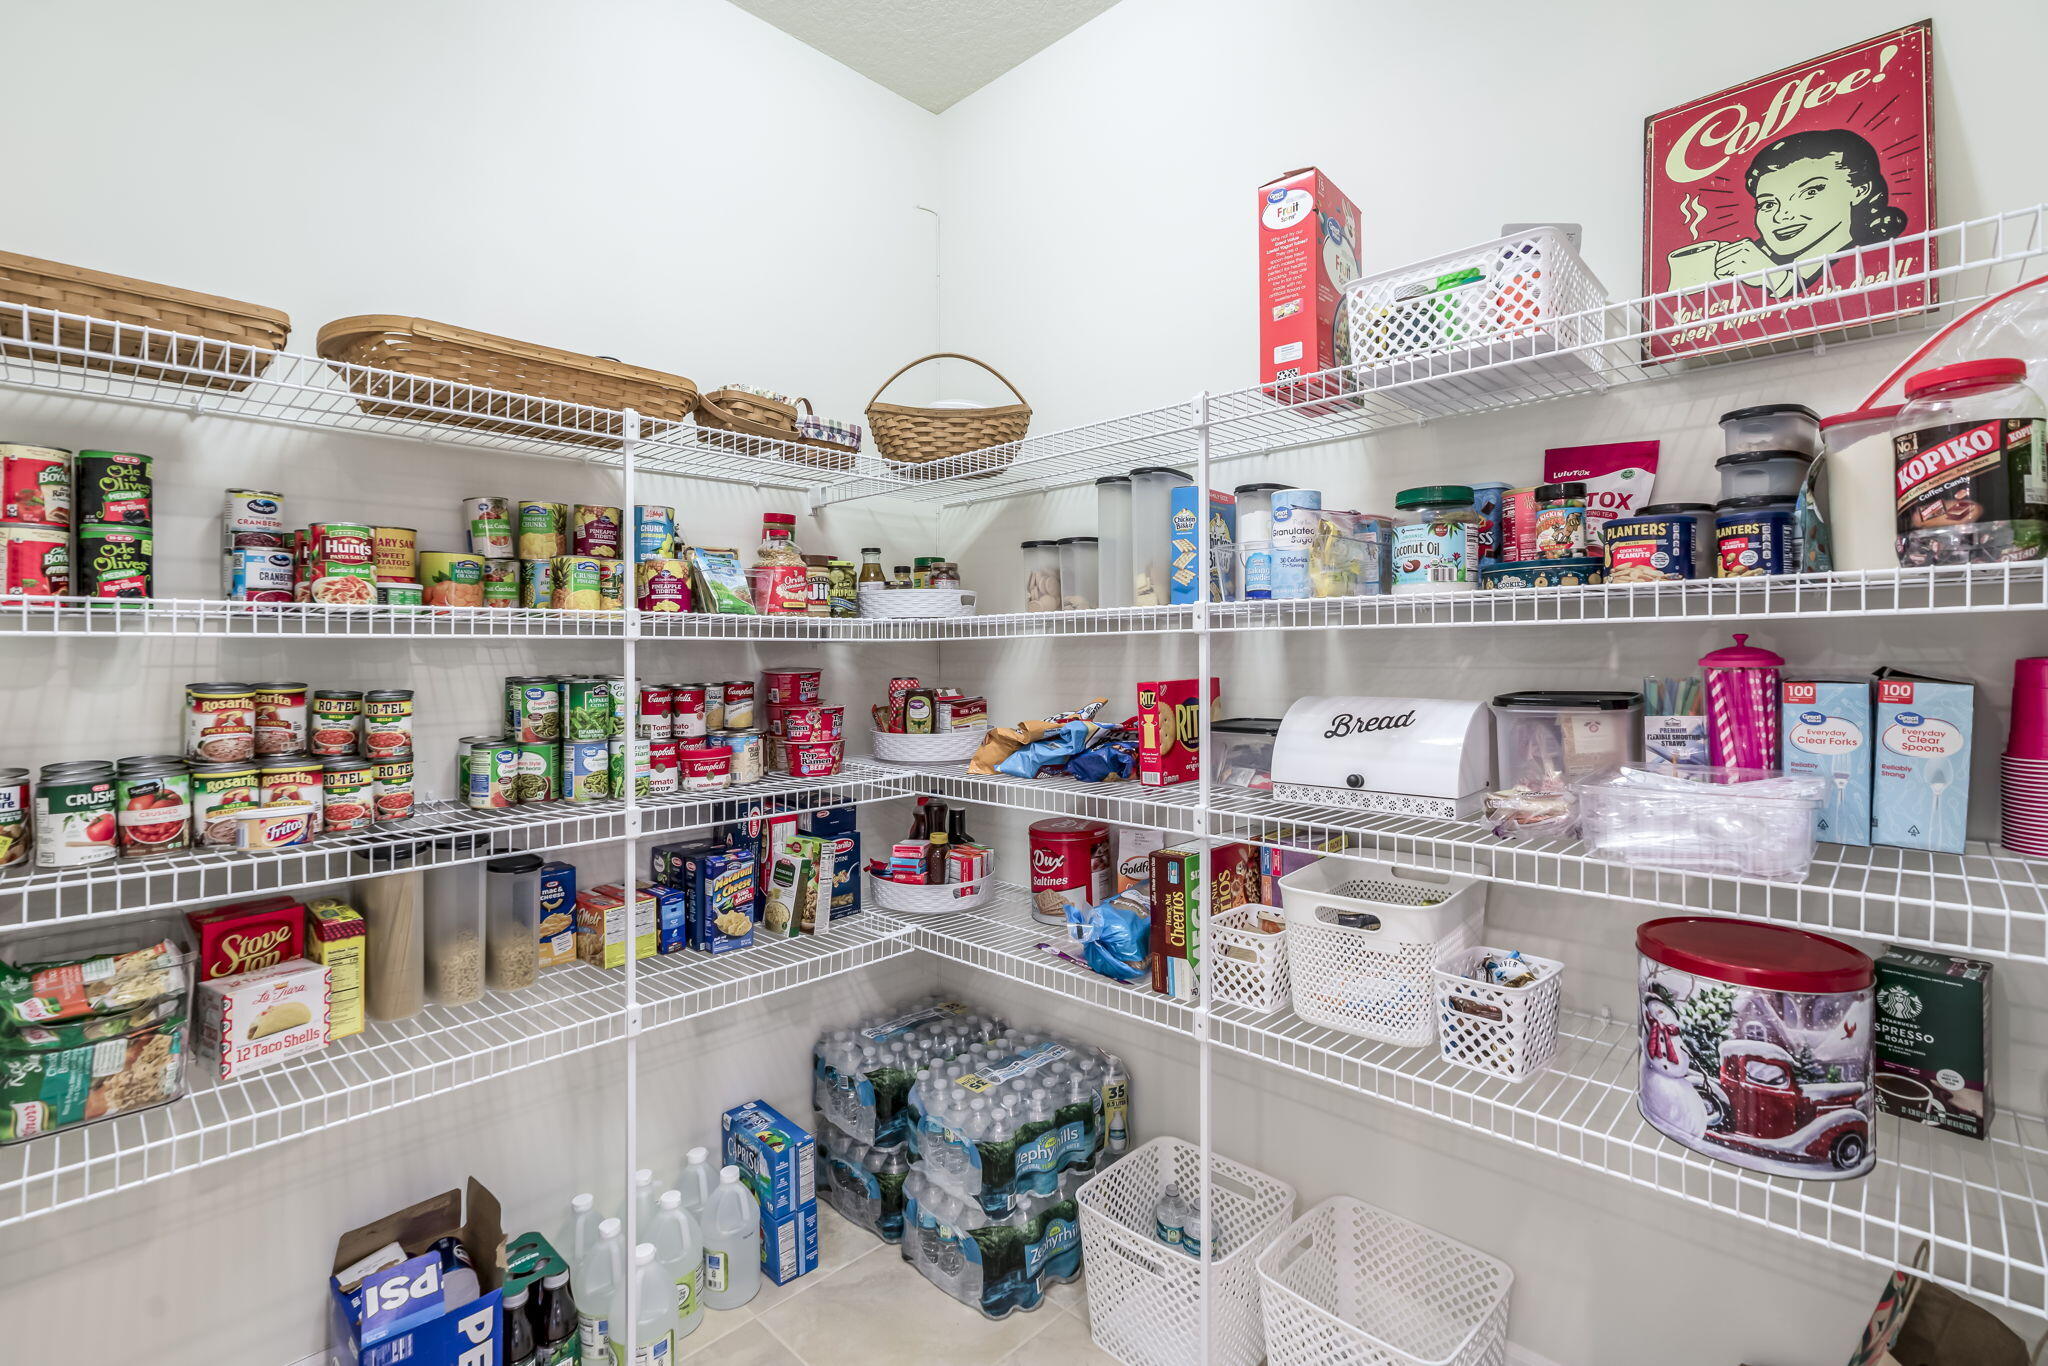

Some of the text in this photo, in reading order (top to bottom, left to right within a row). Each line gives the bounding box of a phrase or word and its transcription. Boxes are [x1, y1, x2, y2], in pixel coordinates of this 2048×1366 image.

[1665, 44, 1898, 183] Coffee!
[1276, 202, 1300, 217] Fruit
[1708, 295, 1742, 316] can
[1670, 323, 1718, 347] sleep
[2007, 427, 2033, 443] KOPI
[1897, 429, 1994, 491] KOPIKO
[106, 464, 141, 477] Ode
[99, 477, 152, 493] Olives
[1918, 476, 1970, 502] Coffee Candy
[1587, 491, 1633, 511] TOX
[640, 524, 664, 533] CHUNK
[1607, 522, 1667, 539] PLANTERS
[1716, 523, 1760, 538] LANTERS
[100, 543, 136, 557] Ode
[1393, 541, 1440, 559] Coconut Oil
[1616, 552, 1651, 560] PEANUTS
[94, 557, 149, 571] Olives
[376, 559, 411, 567] OTATOES
[1139, 691, 1156, 704] RITZ
[1788, 685, 1814, 697] 100
[1883, 684, 1911, 697] 100
[202, 698, 254, 712] Rosarita
[255, 694, 292, 705] sarita
[1176, 704, 1199, 741] RIT
[1802, 713, 1822, 721] Great
[1897, 714, 1919, 722] Great
[1323, 710, 1416, 739] Bread
[1806, 728, 1847, 737] Everyday
[1901, 727, 1946, 738] Everyday
[1907, 735, 1940, 744] Clear
[1797, 736, 1858, 746] Clear Forks
[1901, 742, 1945, 753] Spoons
[634, 749, 649, 757] iant
[800, 752, 817, 760] Top
[1790, 761, 1819, 769] Reliably
[1881, 763, 1912, 772] Reliably
[1881, 770, 1906, 779] Strong
[207, 776, 259, 792] Rosarita
[650, 778, 674, 786] omato
[65, 790, 115, 807] CRUSHE
[138, 808, 178, 817] CRUSHED
[266, 819, 303, 840] Fritos
[835, 841, 852, 850] arilla
[834, 855, 848, 863] OTINI
[1033, 848, 1065, 869] Dux
[1119, 861, 1149, 876] Goldfi
[714, 866, 753, 892] Macaroni
[1033, 874, 1068, 887] Saltines
[540, 891, 566, 901] cheese
[715, 877, 752, 903] & Cheese
[1169, 890, 1185, 948] Cheerios
[210, 926, 291, 978] Stove
[273, 984, 305, 1000] Tiara
[1880, 1017, 1919, 1029] STARBUCKS
[1874, 1022, 1935, 1044] SPRESSO
[235, 1028, 321, 1063] 12 Taco Shells
[1884, 1034, 1915, 1047] ROAST
[1108, 1084, 1125, 1099] 35
[1016, 1128, 1079, 1167] Zephyhills
